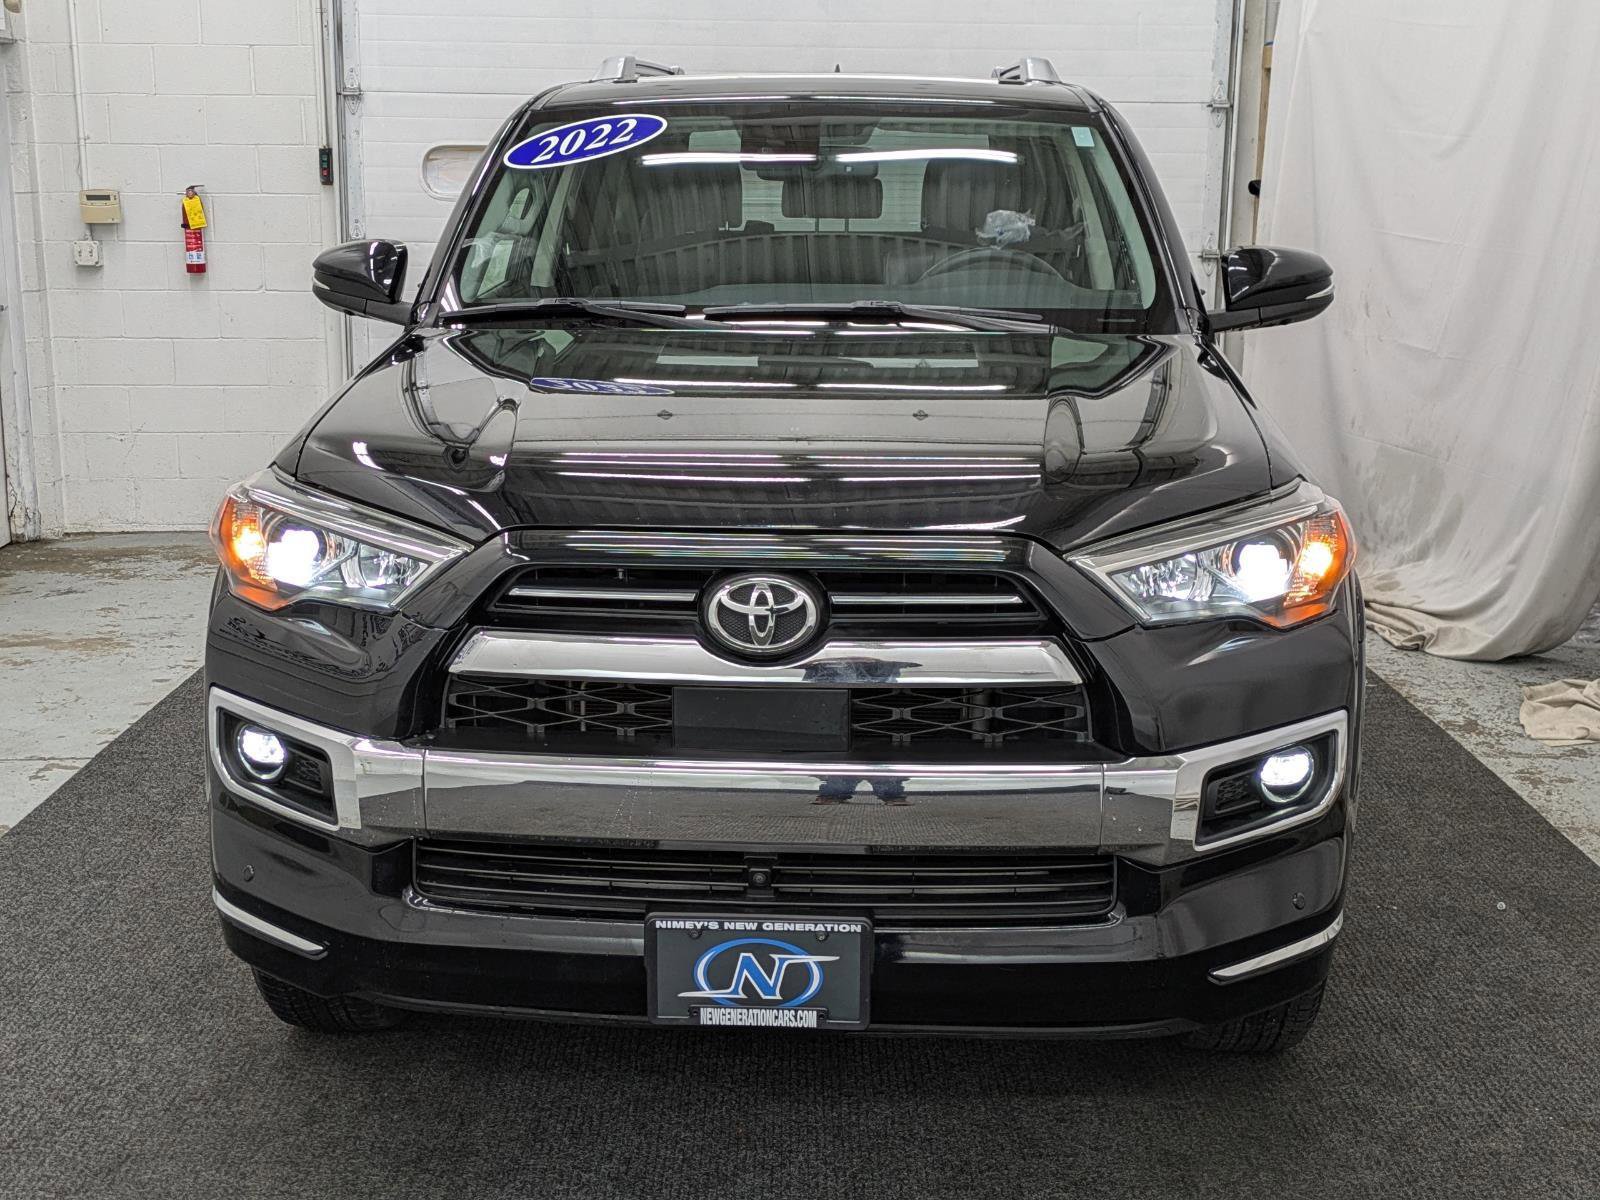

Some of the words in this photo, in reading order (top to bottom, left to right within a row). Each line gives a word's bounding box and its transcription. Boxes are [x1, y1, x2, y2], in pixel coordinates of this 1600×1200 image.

[531, 118, 638, 164] 2022
[655, 920, 719, 930] NIMEY'S
[724, 921, 758, 931] NEW
[762, 922, 862, 933] GENERATION
[700, 1007, 817, 1028] NEWGENERATIONCARS.COM
